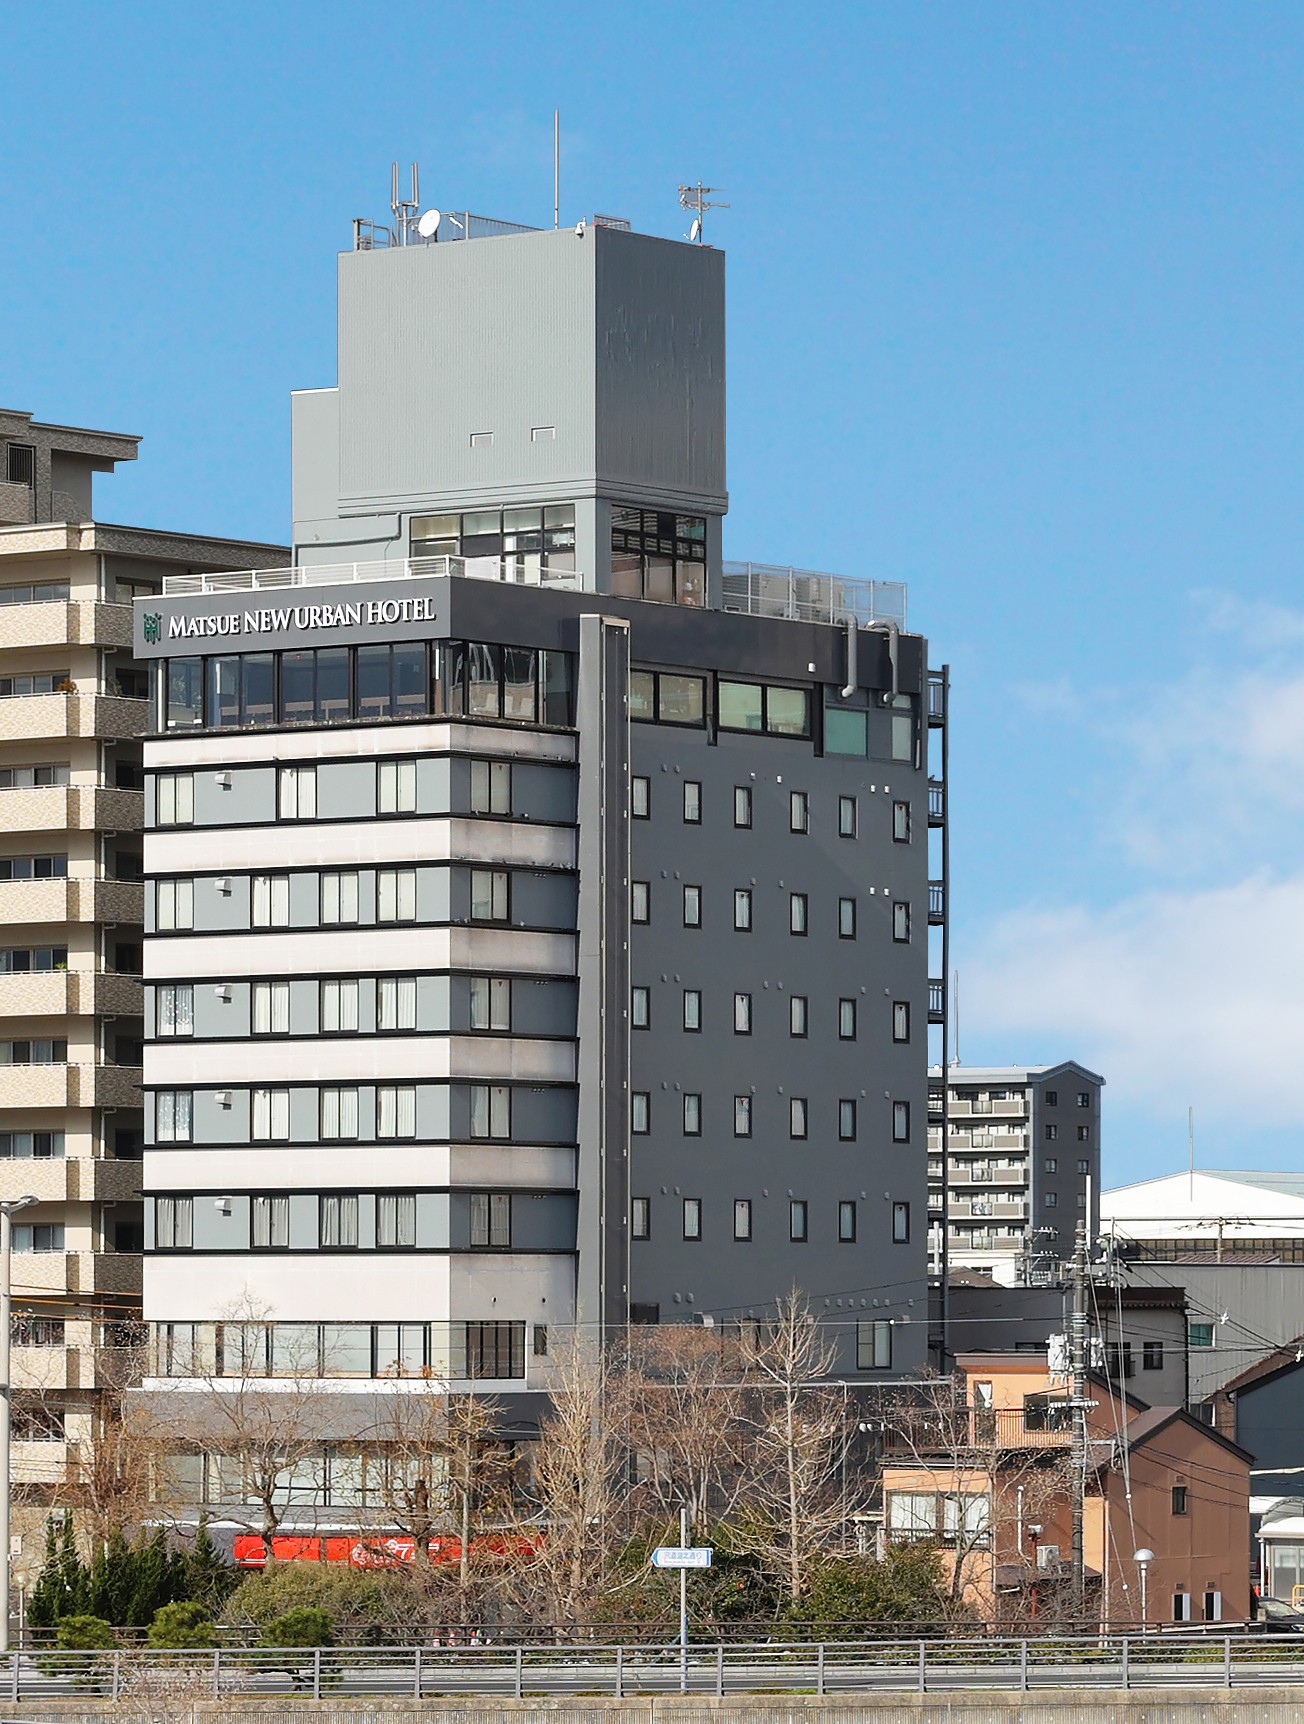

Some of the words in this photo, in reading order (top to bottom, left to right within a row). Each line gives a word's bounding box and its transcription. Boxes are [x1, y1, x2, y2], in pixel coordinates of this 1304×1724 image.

[168, 613, 240, 639] MATSUE
[243, 609, 291, 634] NEW
[290, 602, 363, 629] URBAN
[366, 598, 436, 623] HOTEL
